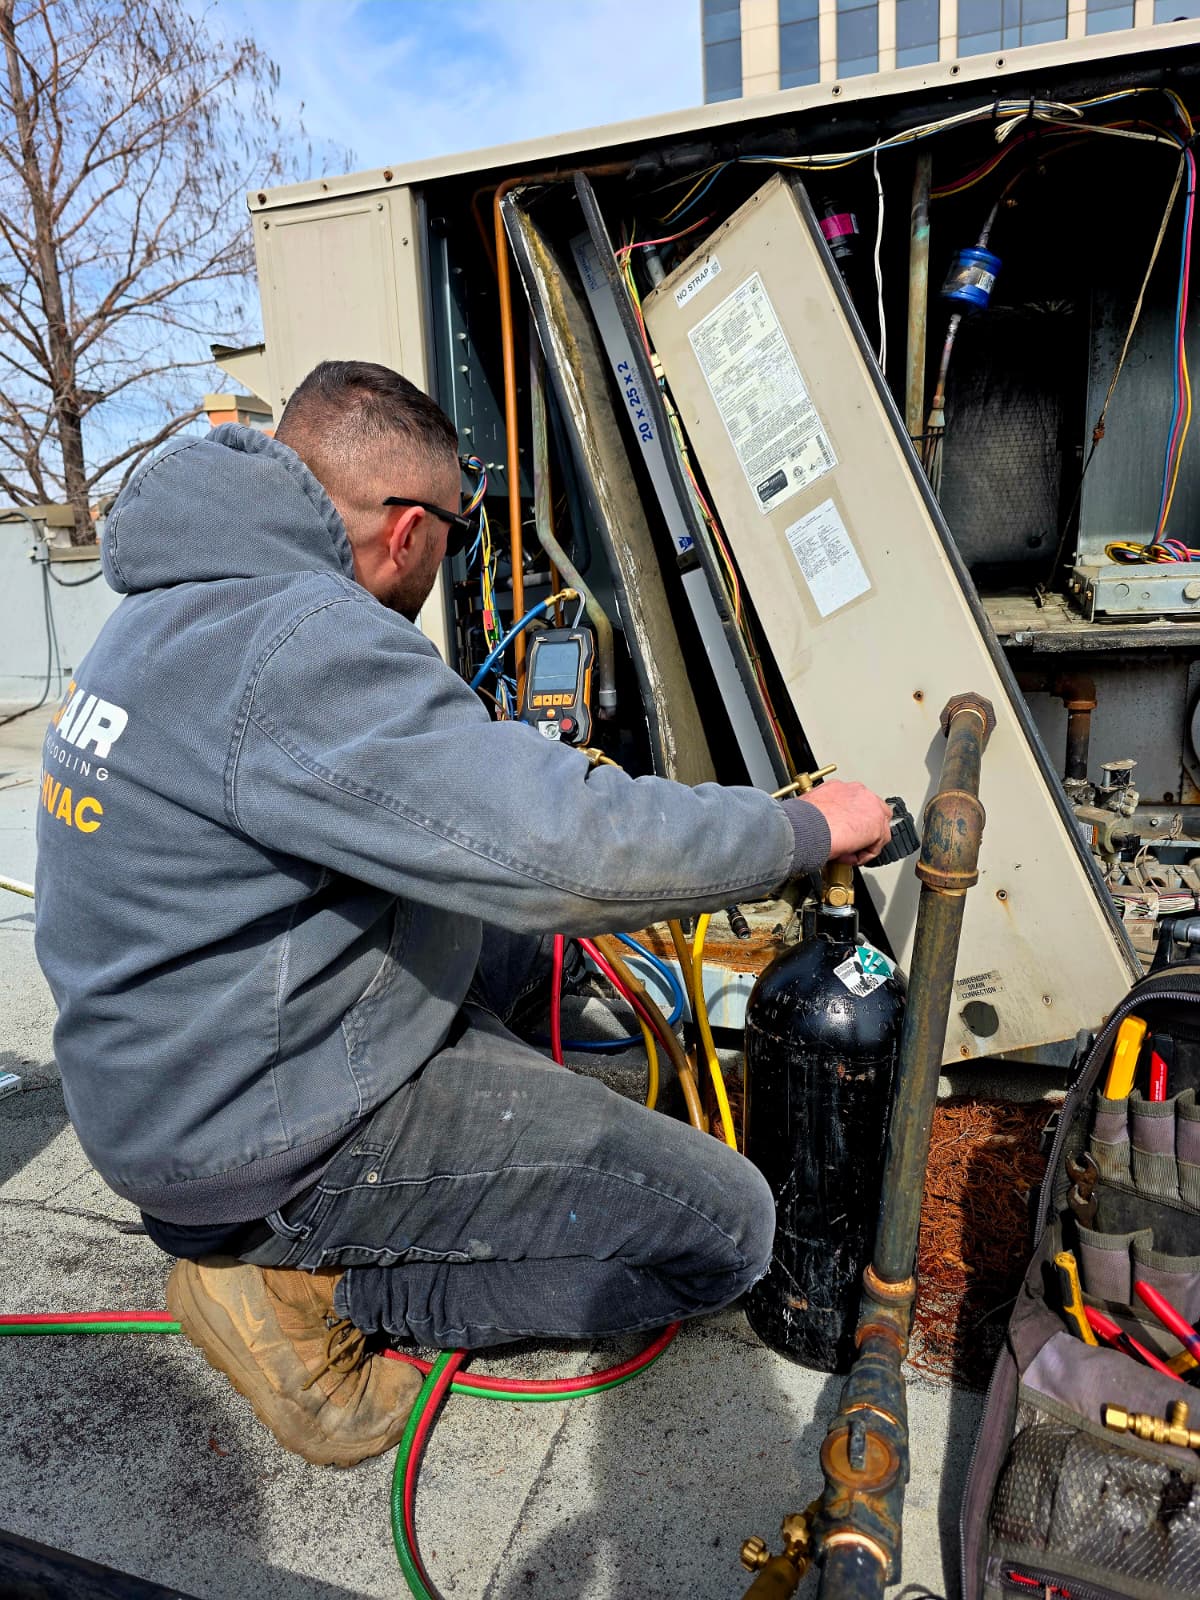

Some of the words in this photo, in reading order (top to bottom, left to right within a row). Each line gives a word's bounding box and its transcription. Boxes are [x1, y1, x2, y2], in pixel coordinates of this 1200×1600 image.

[676, 289, 687, 302] NO
[687, 268, 709, 292] STRAP
[617, 361, 629, 373] 2
[626, 387, 641, 407] 25
[639, 422, 654, 443] 20
[56, 689, 129, 759] AIR
[956, 971, 993, 987] CONDENSATE
[967, 982, 986, 991] DRAIN
[961, 986, 997, 999] CONNECTION
